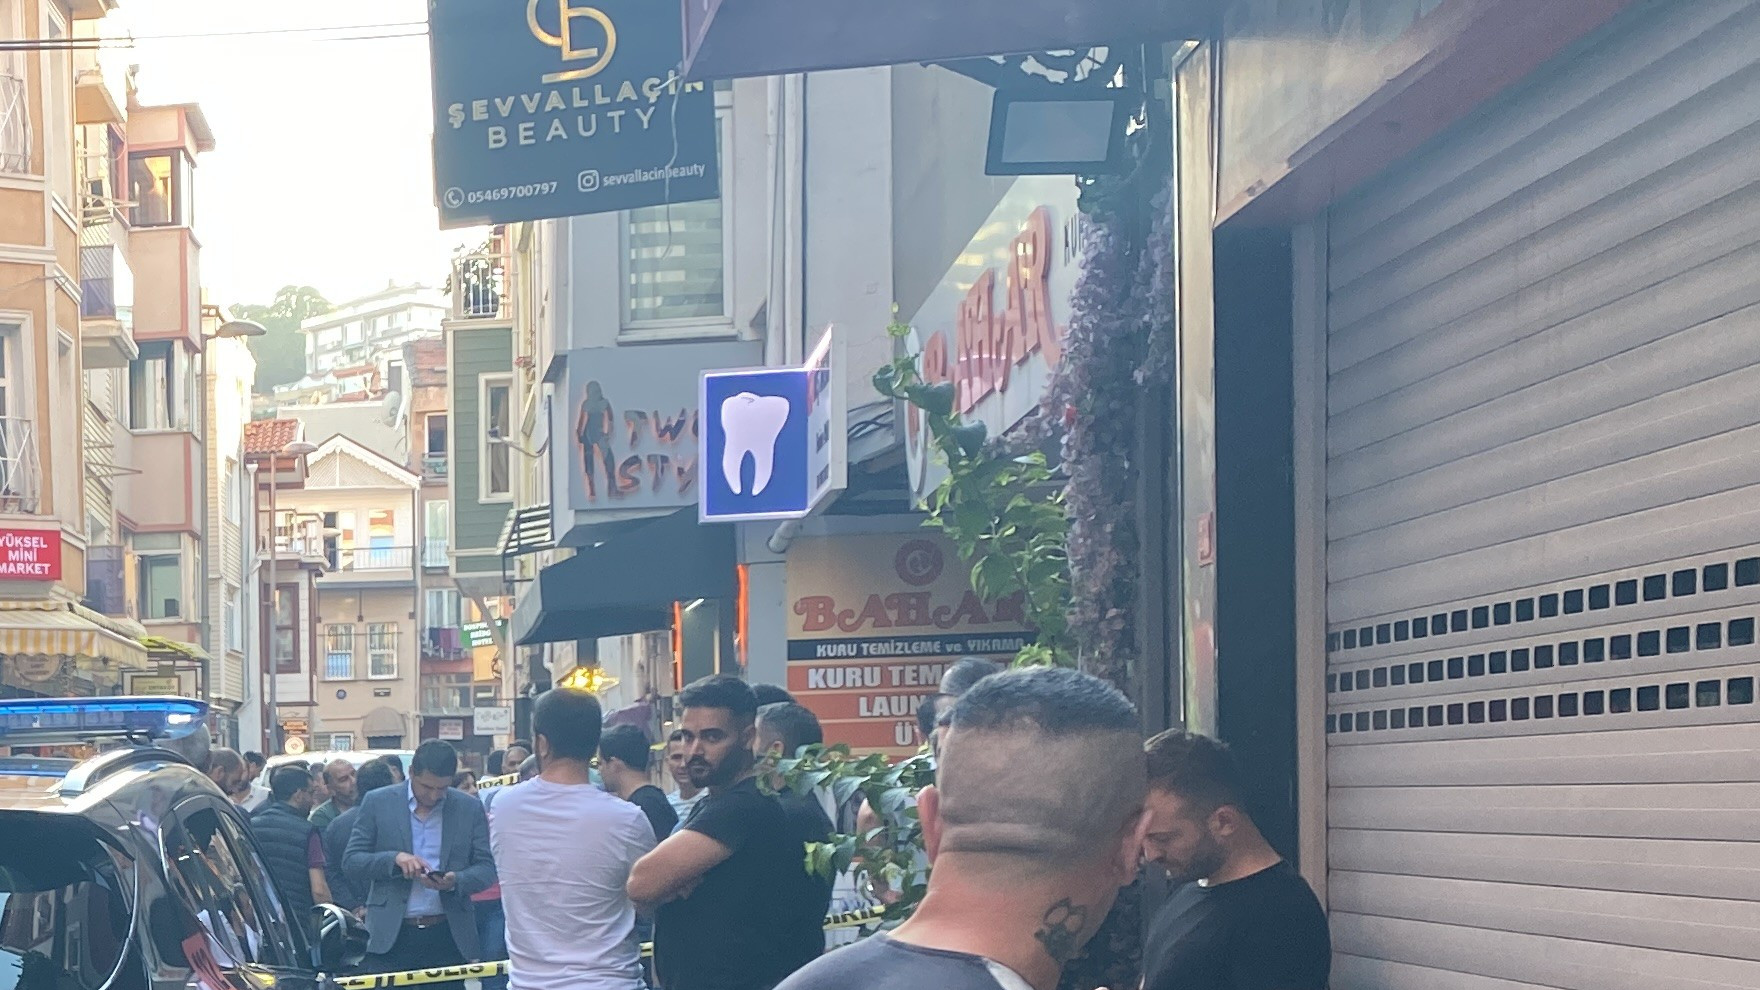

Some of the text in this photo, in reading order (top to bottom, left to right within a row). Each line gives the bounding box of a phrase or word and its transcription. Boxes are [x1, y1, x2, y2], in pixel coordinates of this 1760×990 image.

[488, 106, 656, 149] BEAUTY
[467, 163, 705, 203] 05469700797 sevvallacinbeauty
[816, 644, 857, 658] KURU
[861, 639, 941, 656] TEMİZLEME
[808, 666, 882, 689] KURU
